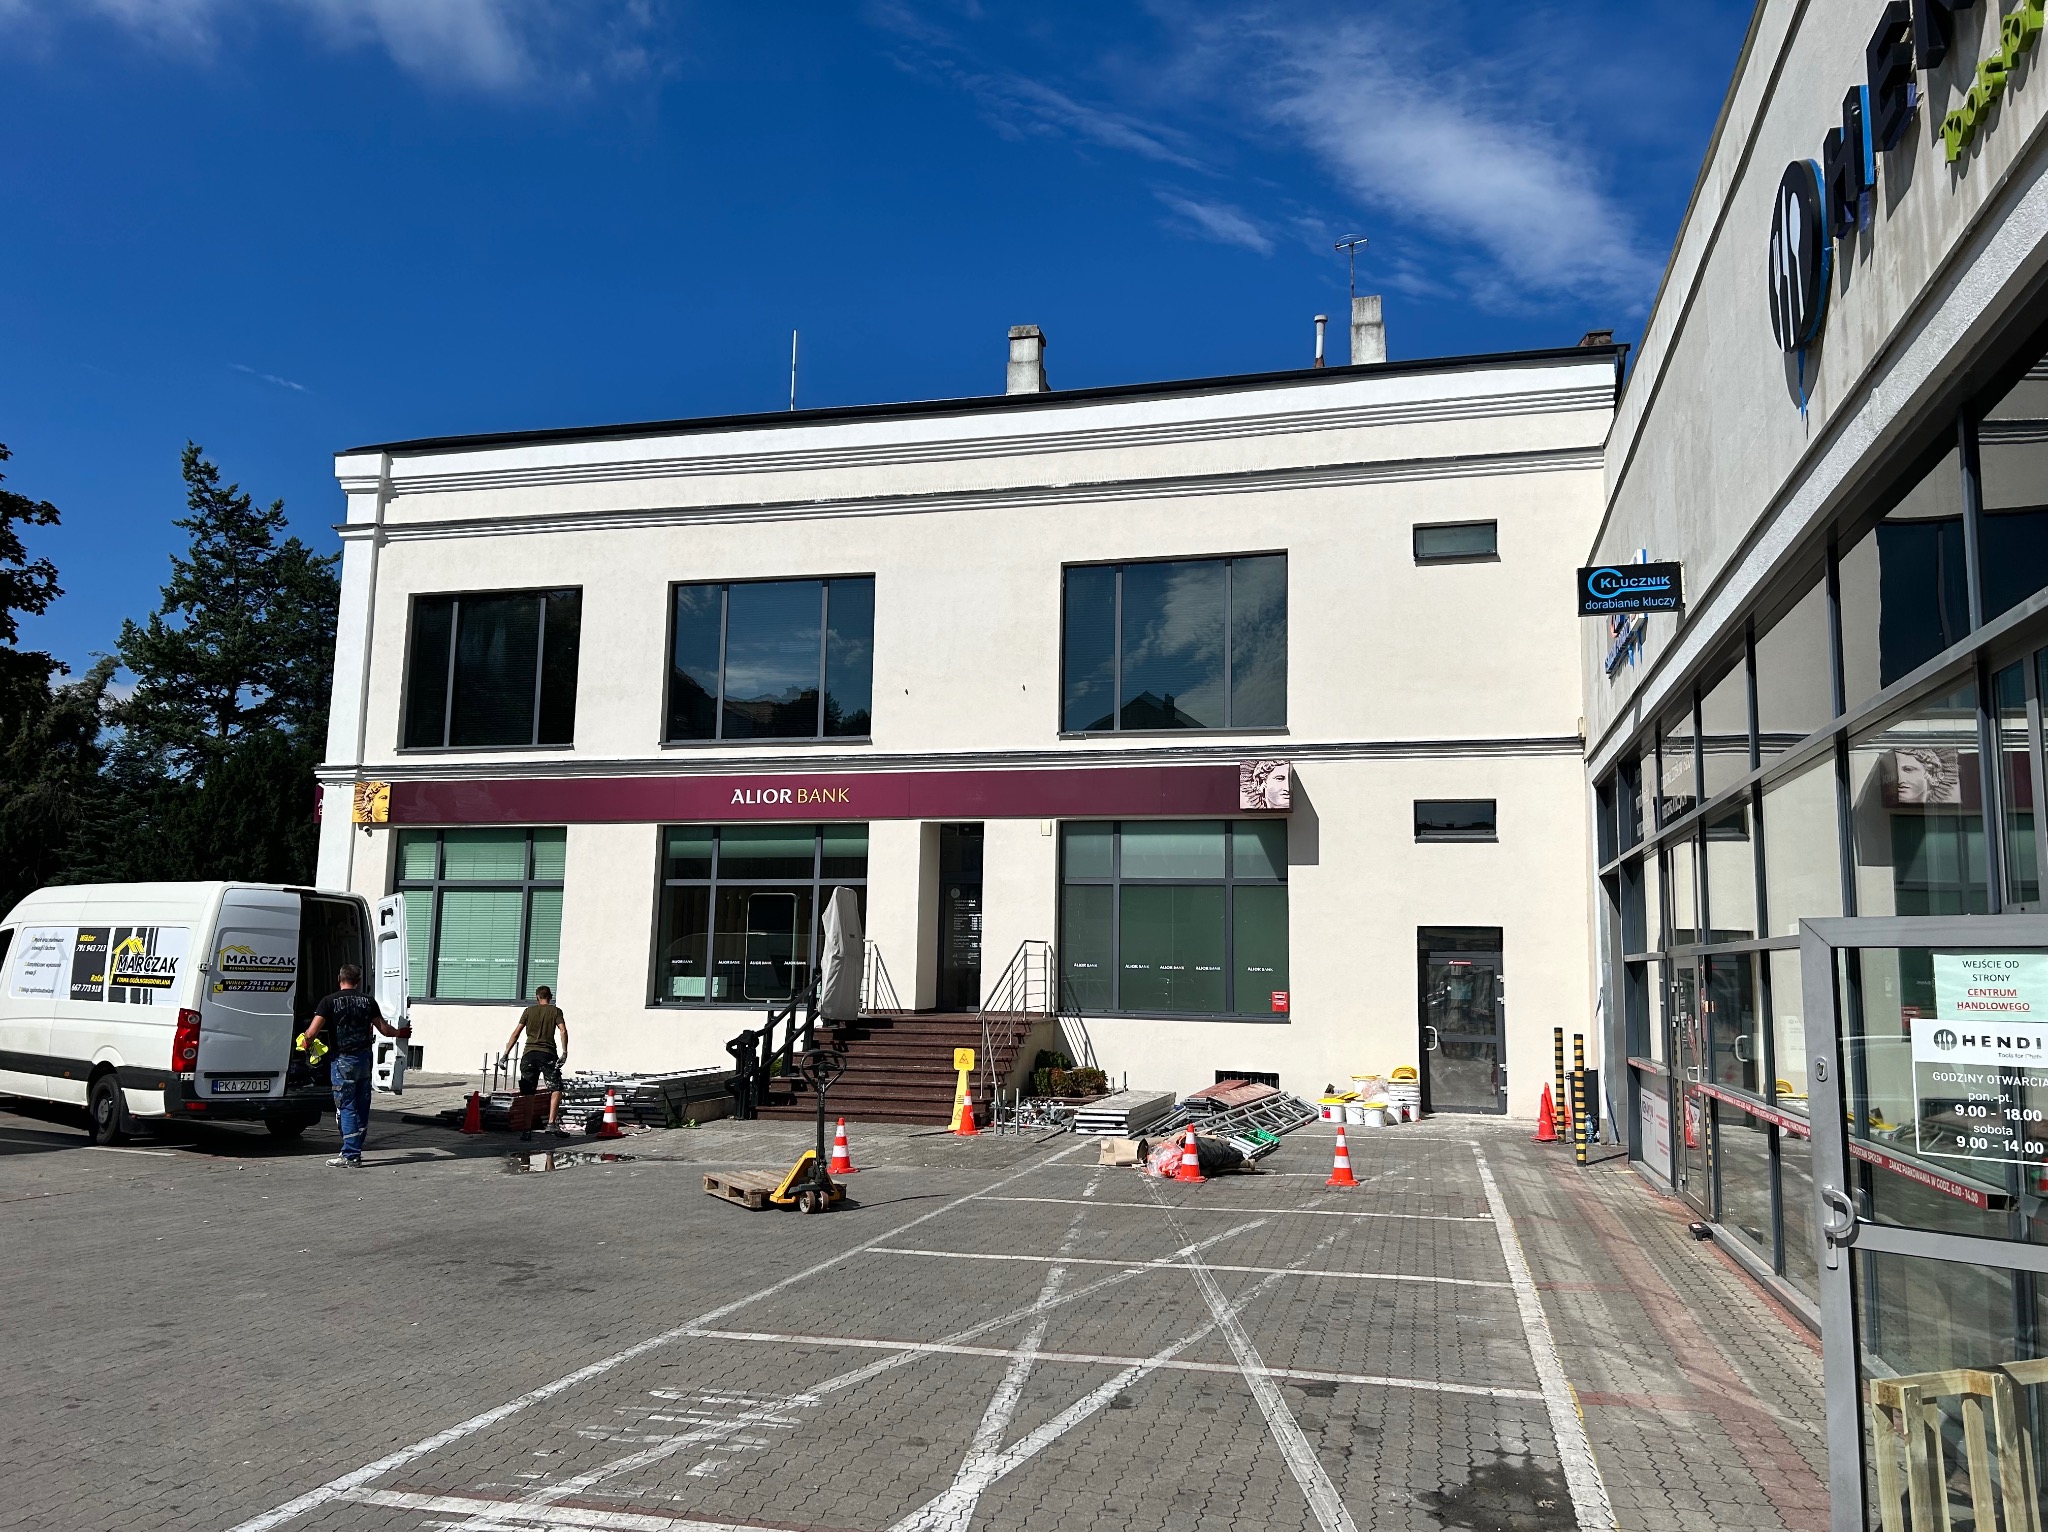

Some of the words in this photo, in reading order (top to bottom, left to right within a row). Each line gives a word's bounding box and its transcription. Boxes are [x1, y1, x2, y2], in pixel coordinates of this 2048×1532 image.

[1600, 576, 1671, 588] KLUCZNIK
[1585, 598, 1640, 610] dorabianie
[1642, 596, 1676, 609] kluczy
[731, 788, 793, 805] ALIOR
[797, 787, 850, 804] BANK
[116, 955, 179, 974] MARCZAK
[225, 955, 296, 966] MARCZAK
[1961, 959, 2001, 969] WEJŚCIE
[2004, 960, 2020, 969] OD
[1972, 973, 2011, 982] STRONY
[1967, 988, 2017, 997] CENTRUM
[1957, 1001, 2030, 1011] HANDLOWEGO
[1962, 1034, 2042, 1050] HENDI
[218, 1081, 237, 1091] PKA
[240, 1080, 269, 1091] 27015
[1932, 1071, 1984, 1084] GODZINY
[1986, 1074, 2048, 1088] OTWARCIA
[1968, 1092, 2013, 1104] pon.-pt.
[1954, 1104, 1987, 1118] 9.00
[2003, 1108, 2043, 1122] 18.00
[1973, 1124, 2014, 1136] sobota
[1956, 1136, 1988, 1150] 9.00
[2002, 1140, 2044, 1155] 14.00
[1888, 1159, 1902, 1173] ZAKAZ
[1902, 1165, 1931, 1185] PARKOWANIA
[1931, 1176, 1937, 1186] W
[1936, 1178, 1951, 1193] GODZ.
[1951, 1185, 1962, 1197] 6.00
[1964, 1189, 1979, 1204] 14.00
